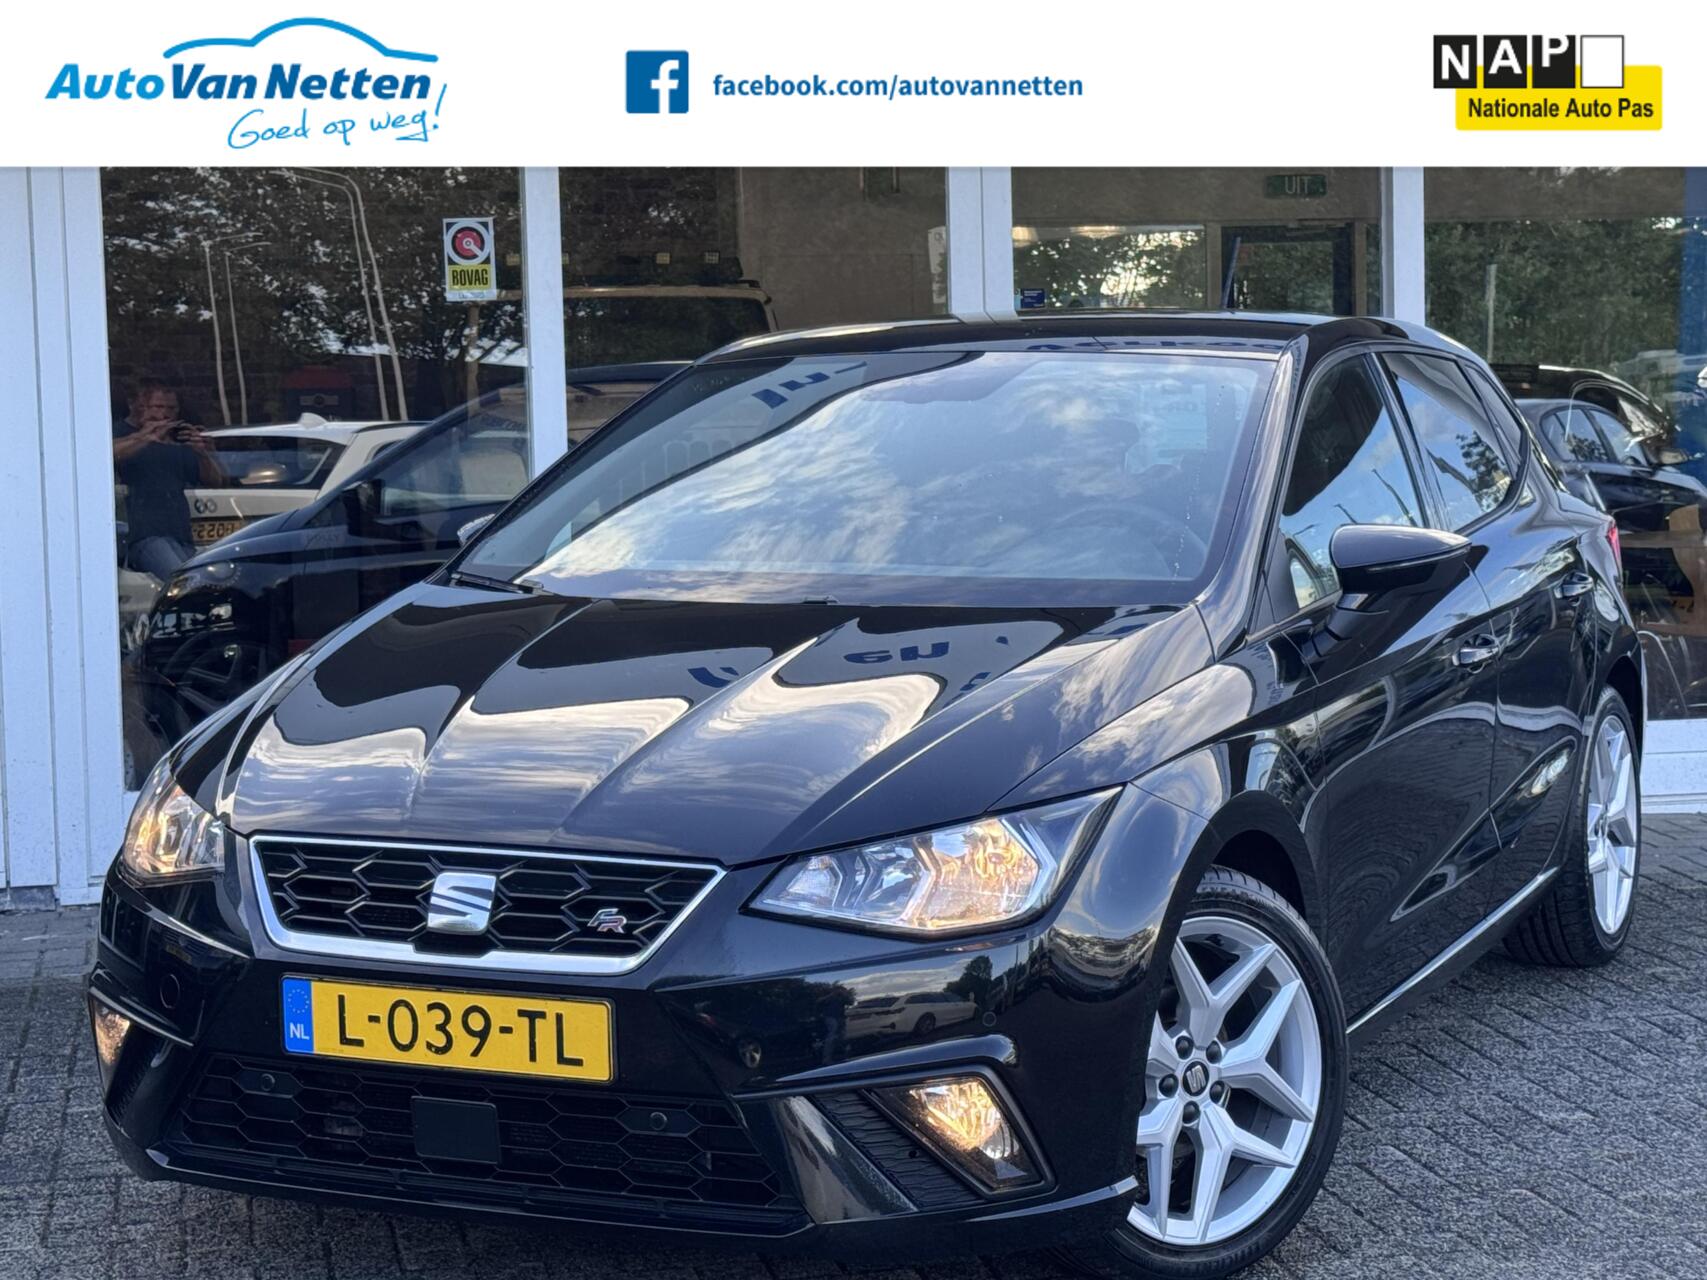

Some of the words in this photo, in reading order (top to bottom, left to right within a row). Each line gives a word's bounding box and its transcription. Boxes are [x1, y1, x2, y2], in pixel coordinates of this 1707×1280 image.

[1284, 175, 1312, 194] UIT
[451, 268, 488, 287] BOVAG
[289, 1022, 310, 1041] NL
[337, 993, 584, 1067] L-039-TL
